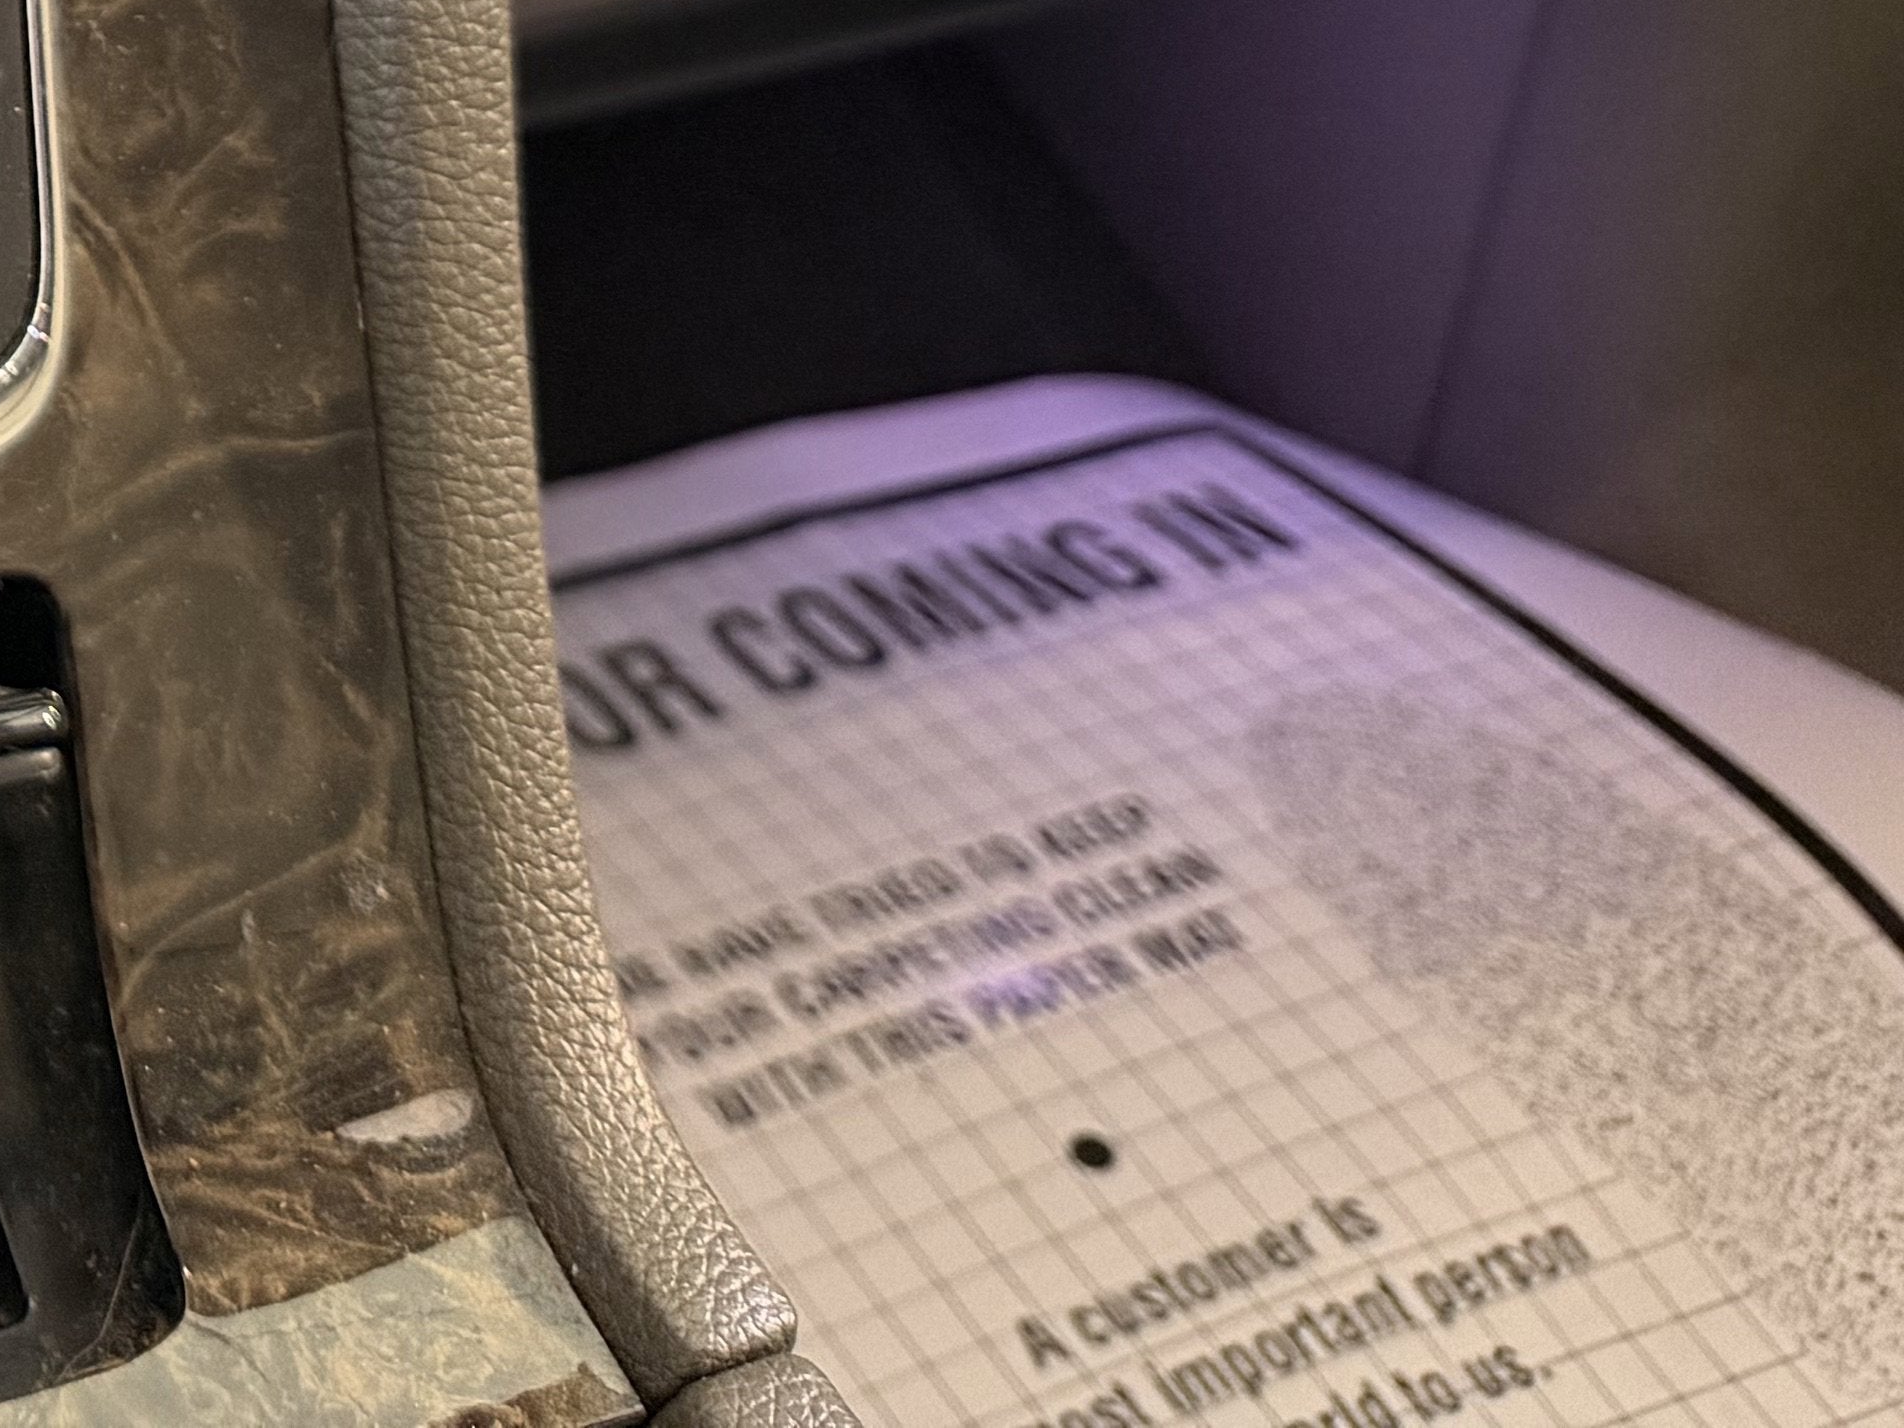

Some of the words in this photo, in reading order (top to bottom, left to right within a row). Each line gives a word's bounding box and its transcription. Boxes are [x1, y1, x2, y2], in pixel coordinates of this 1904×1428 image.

[557, 639, 722, 750] OR
[708, 519, 1162, 696] COMING
[1133, 483, 1302, 574] IN
[1015, 1312, 1072, 1370] A
[1068, 1218, 1314, 1346] customer
[1142, 1275, 1418, 1419] important
[1413, 1222, 1591, 1328] person
[1390, 1369, 1462, 1422] to
